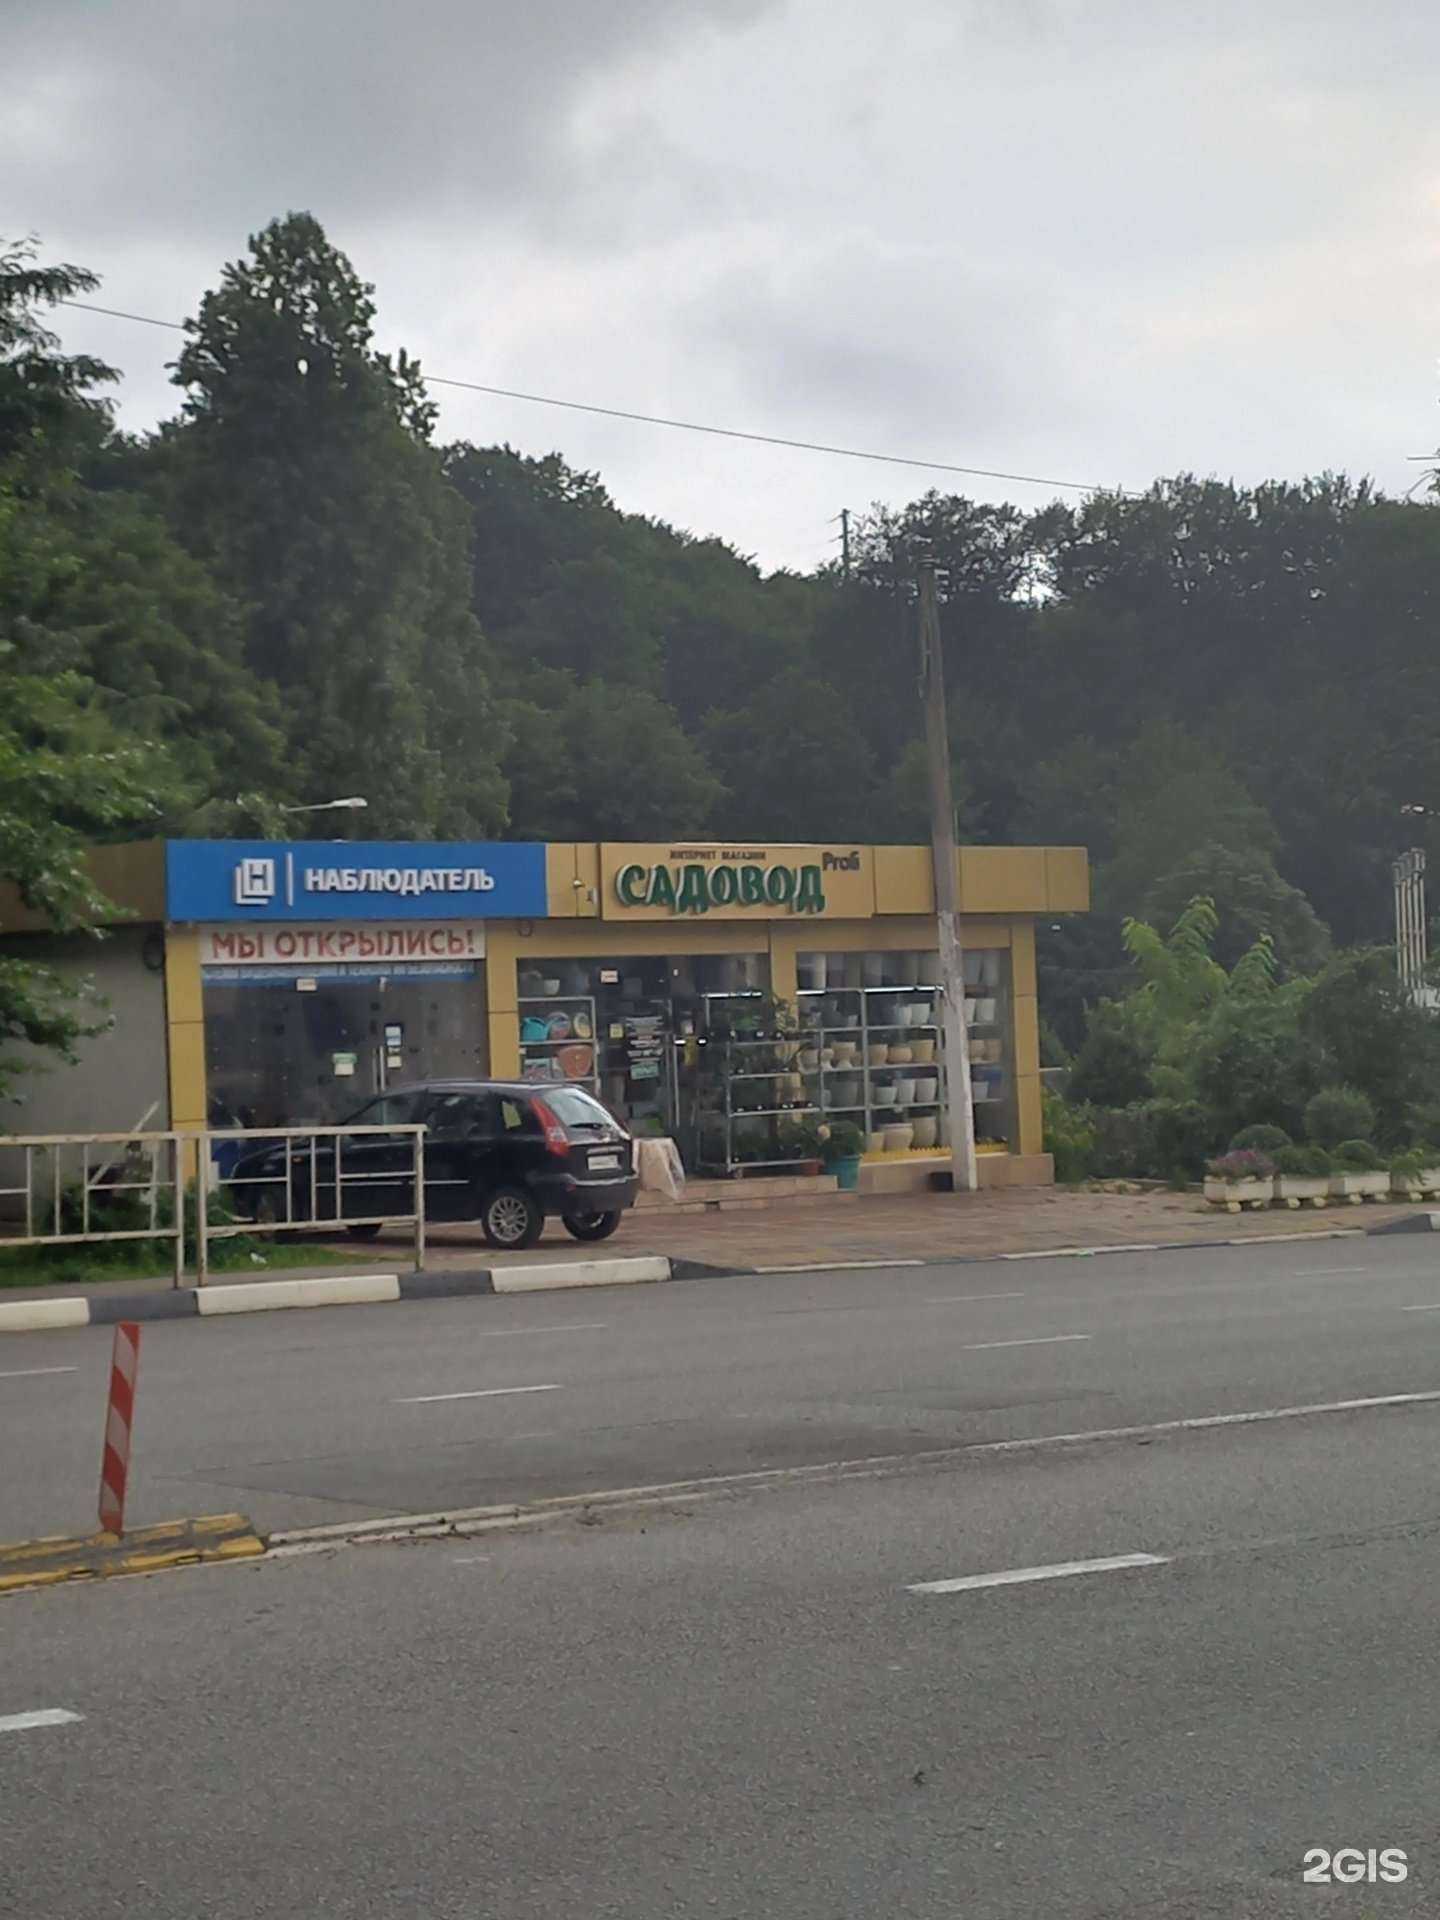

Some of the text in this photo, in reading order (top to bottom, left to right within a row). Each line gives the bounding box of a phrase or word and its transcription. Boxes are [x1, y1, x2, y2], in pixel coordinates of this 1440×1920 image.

[305, 868, 495, 895] НАБЛЮДАТЕЛЬ
[616, 863, 826, 913] САДОВОД
[212, 930, 475, 959] МЫ ОТКРЫЛИСЬ!
